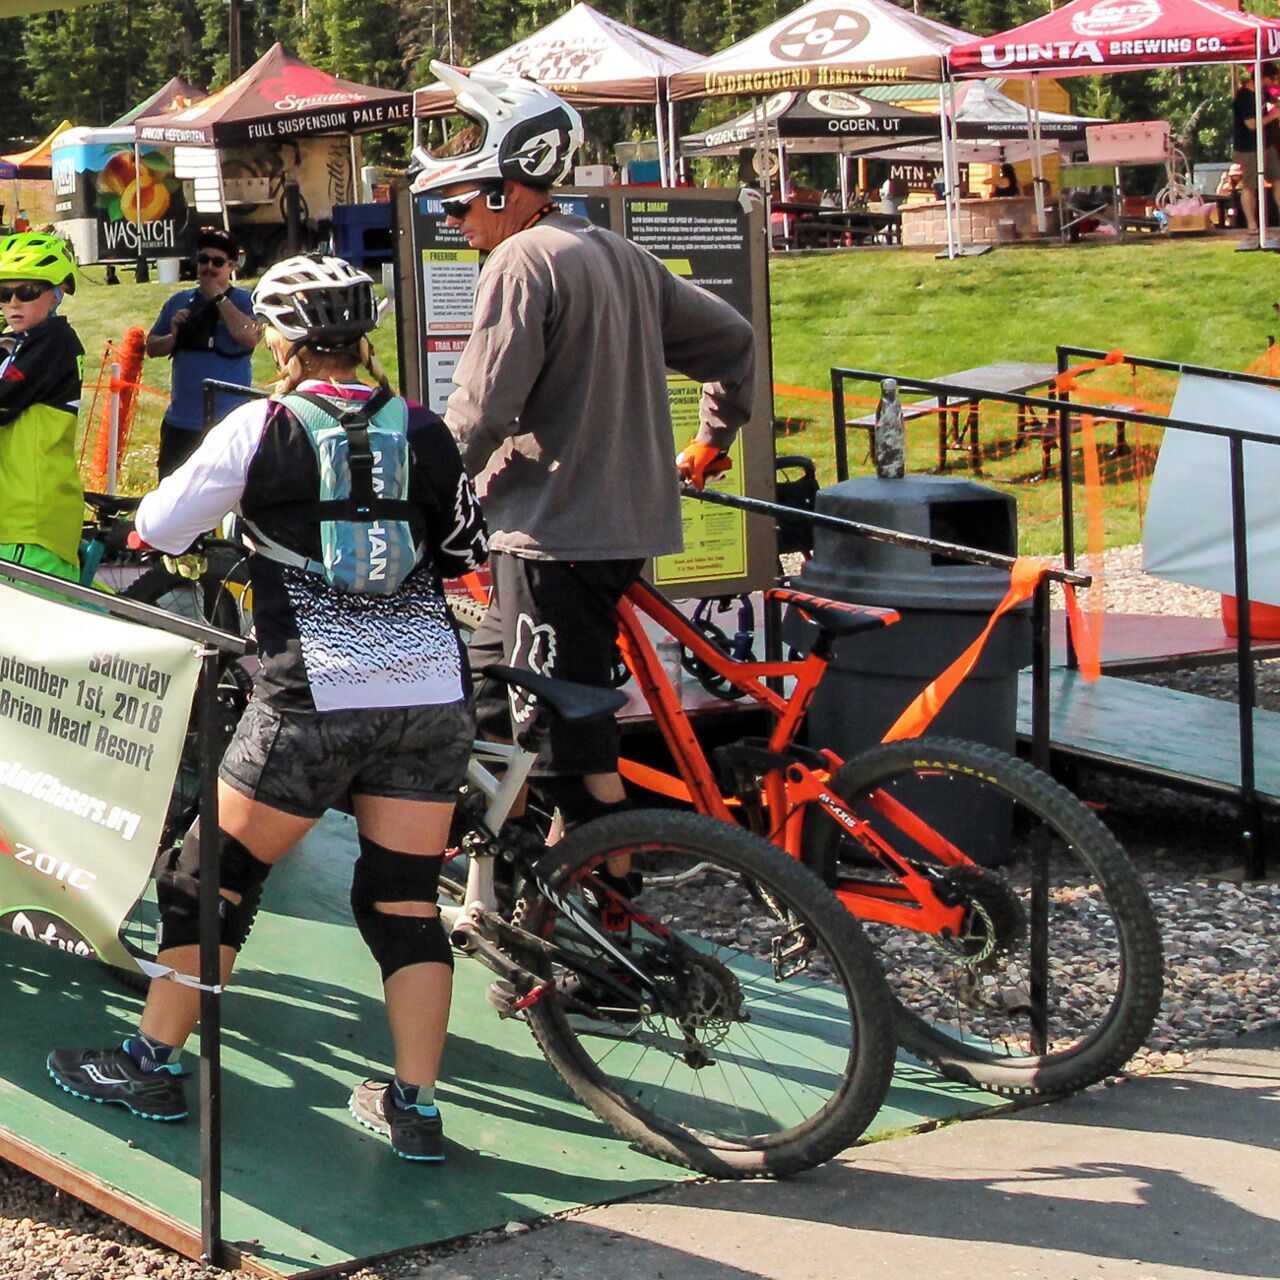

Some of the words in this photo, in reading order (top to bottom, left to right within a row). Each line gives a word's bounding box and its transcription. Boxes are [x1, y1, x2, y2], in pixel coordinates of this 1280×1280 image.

[980, 39, 1104, 68] UINTA
[1109, 37, 1191, 55] BREWING
[1196, 37, 1226, 52] CO.
[704, 67, 811, 94] UNDERGROUND
[817, 65, 865, 85] HERBAL
[867, 63, 908, 80] SPIRIT
[274, 91, 368, 112] Squatters
[248, 123, 275, 139] FULL
[278, 112, 347, 134] SUSPENSION
[353, 107, 383, 124] PALE
[388, 103, 410, 119] ALE
[828, 118, 880, 132] OGDEN,
[883, 118, 900, 131] UT
[88, 651, 172, 701] Saturday
[76, 679, 107, 718] 1st,
[112, 692, 164, 734] 2018
[47, 707, 92, 747] Head
[94, 725, 156, 772] Resort
[913, 760, 998, 784] MAXXIS
[13, 841, 98, 890] ZOIC
